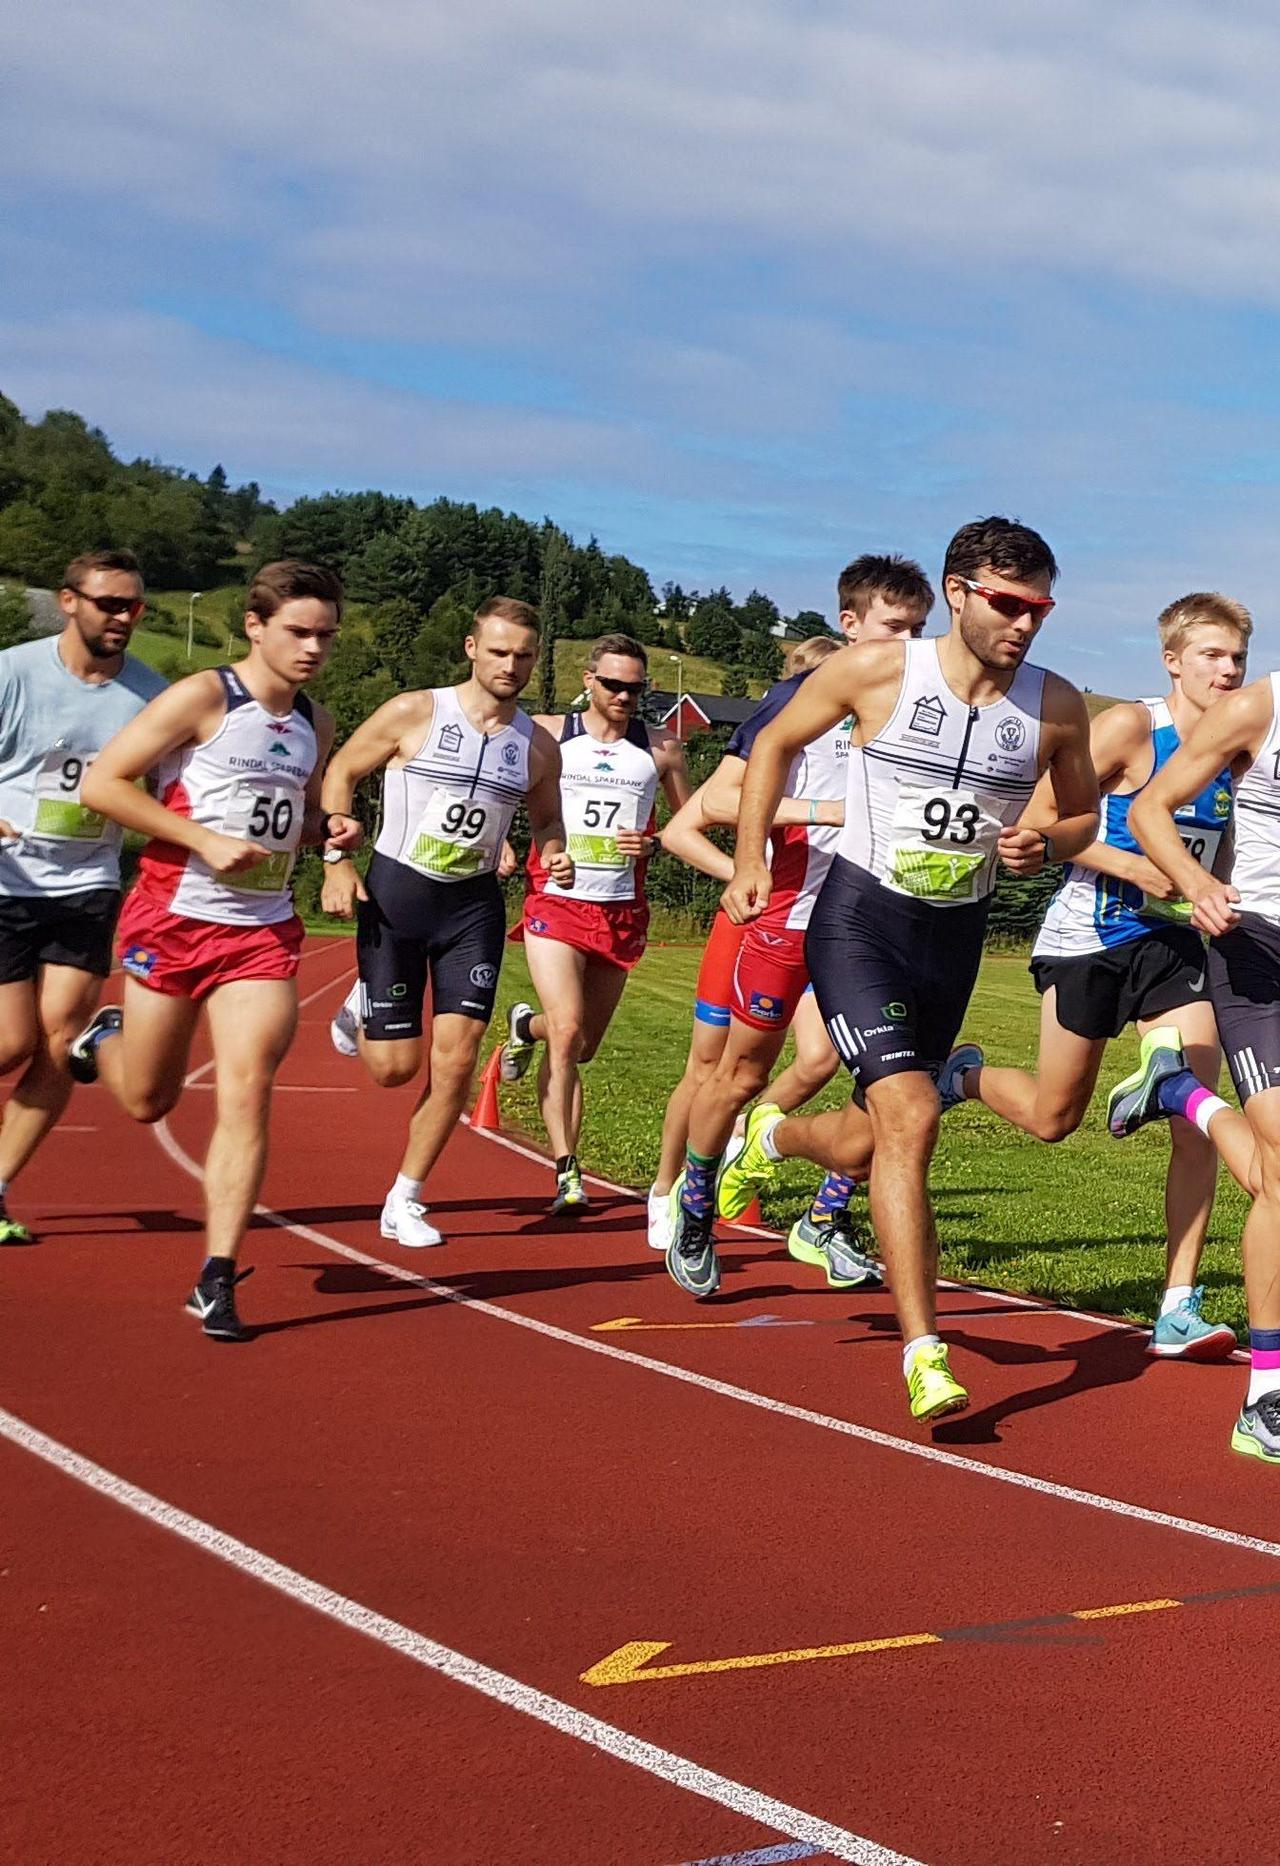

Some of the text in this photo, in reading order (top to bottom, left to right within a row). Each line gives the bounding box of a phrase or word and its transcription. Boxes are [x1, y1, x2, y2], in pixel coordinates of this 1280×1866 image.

[59, 757, 94, 792] 9
[248, 796, 293, 840] 50
[441, 803, 487, 839] 99
[583, 800, 621, 829] 57
[920, 797, 980, 845] 93
[863, 1025, 894, 1037] Orkla
